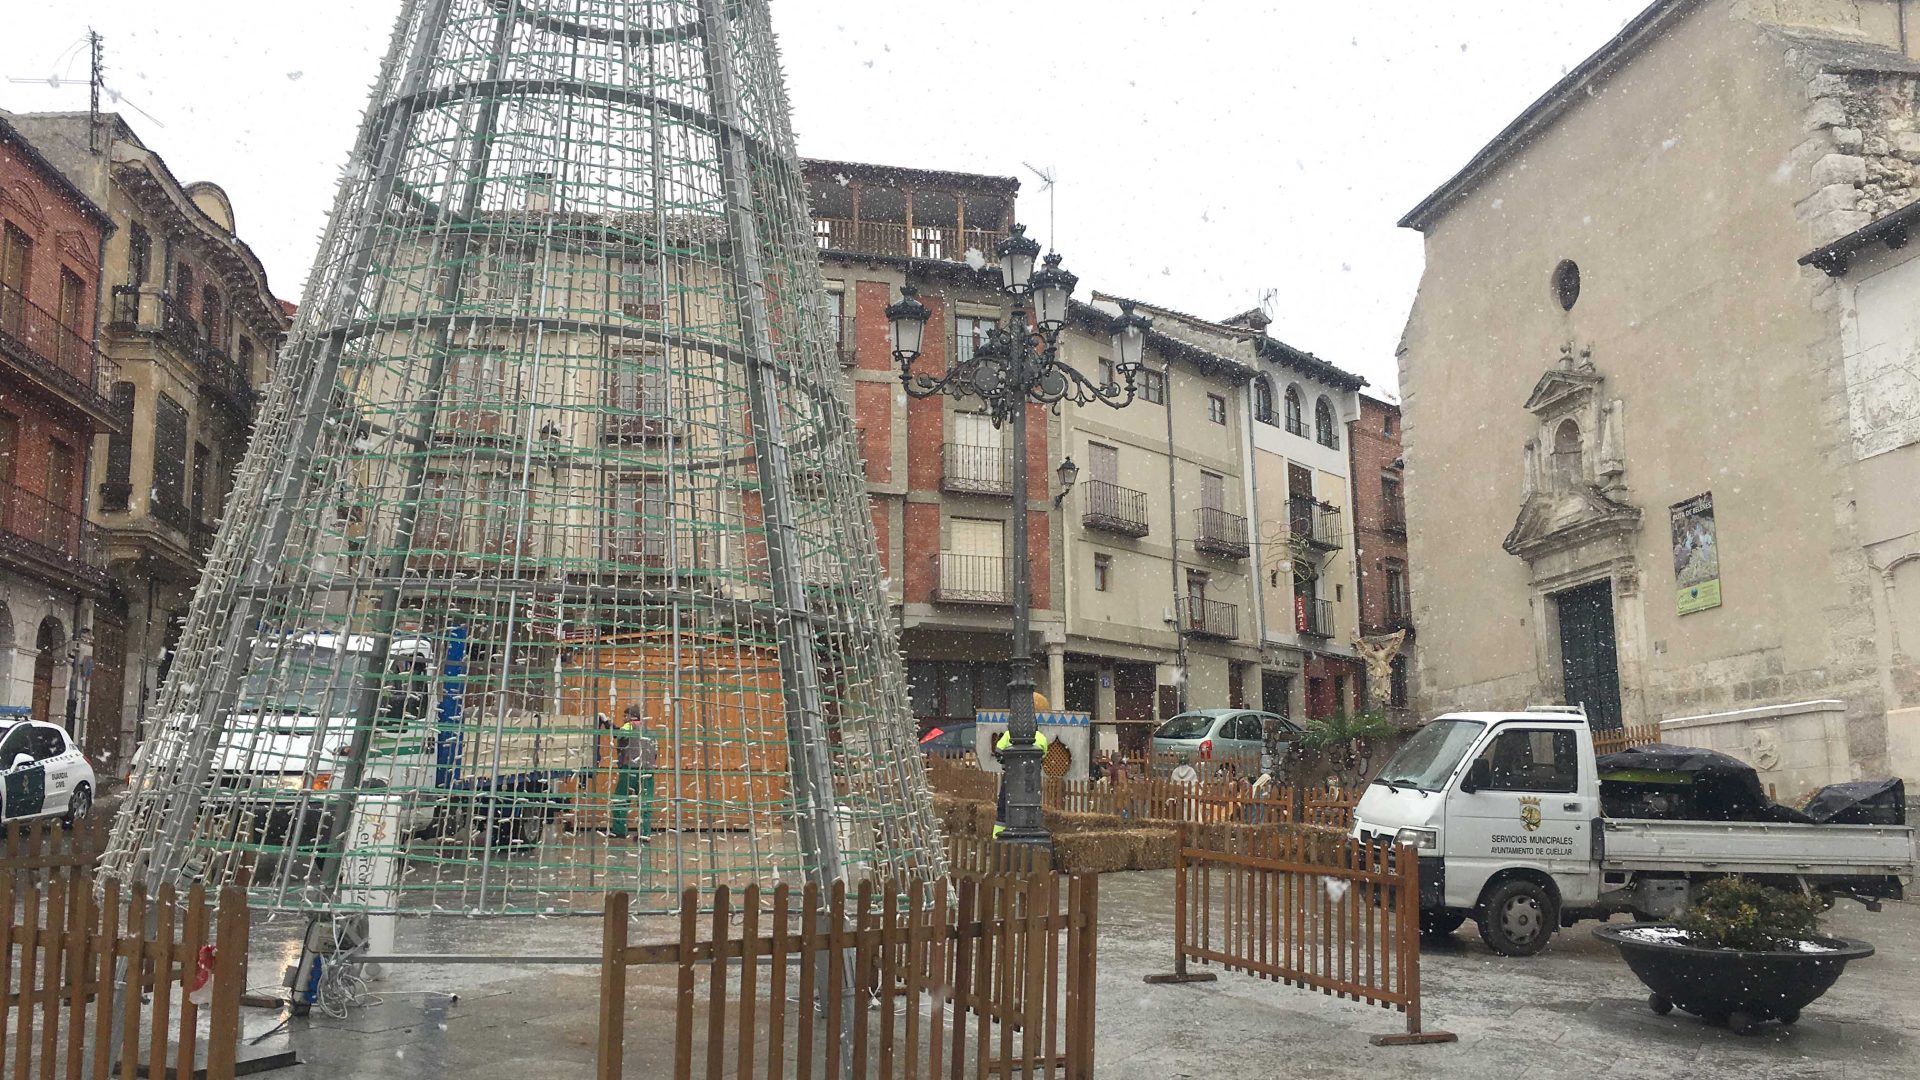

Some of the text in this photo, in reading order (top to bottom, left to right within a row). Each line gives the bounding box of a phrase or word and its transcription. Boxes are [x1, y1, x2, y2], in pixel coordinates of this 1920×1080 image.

[1491, 834, 1573, 845] SERVICIOS MUNICIPALES
[1490, 846, 1534, 855] AYUNTAMIENTO
[1535, 847, 1544, 855] DE
